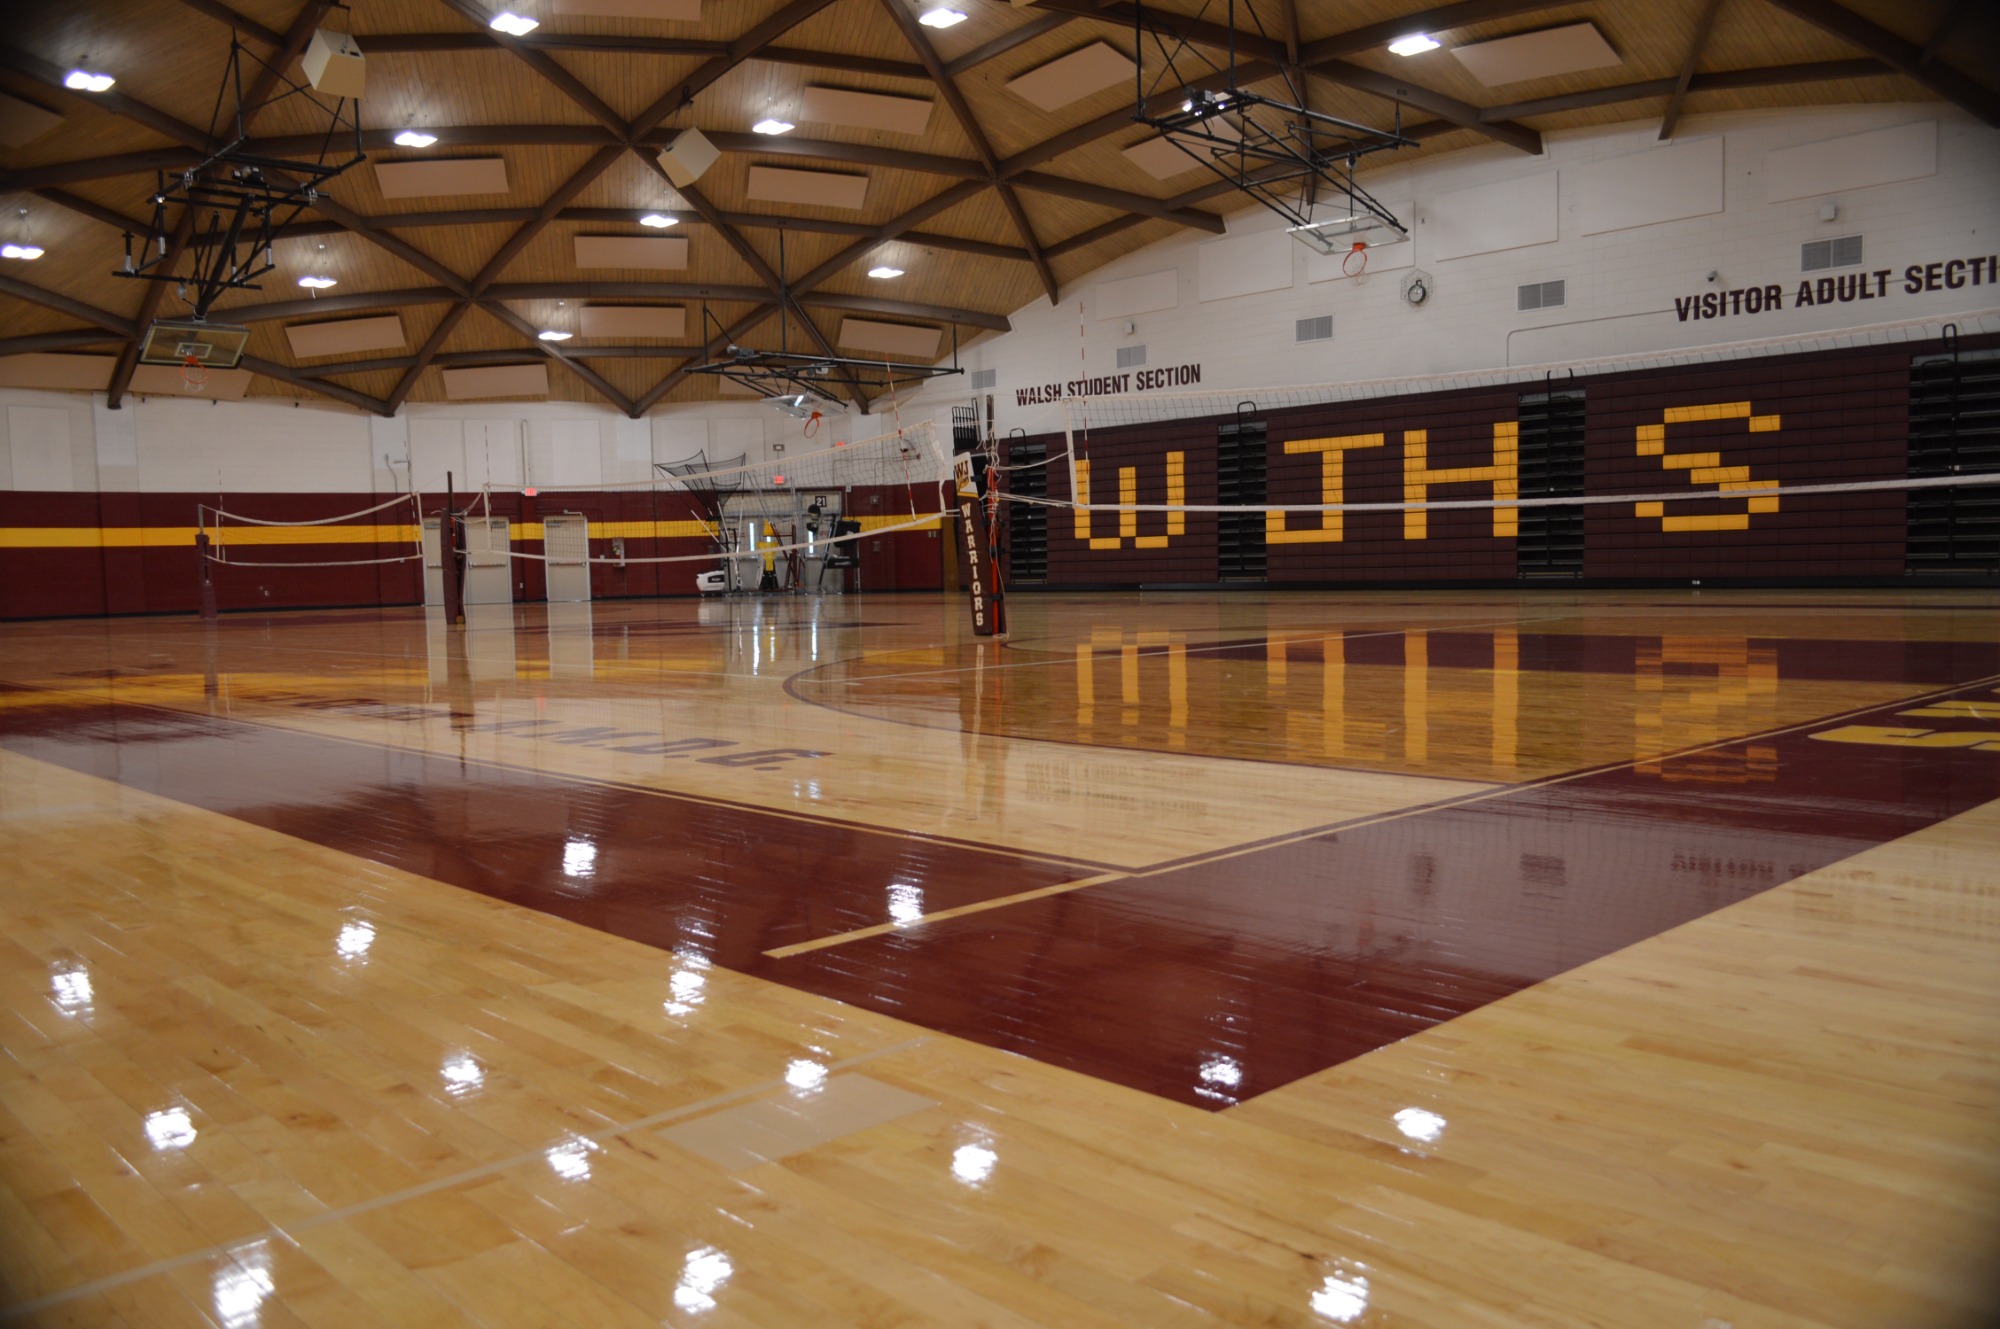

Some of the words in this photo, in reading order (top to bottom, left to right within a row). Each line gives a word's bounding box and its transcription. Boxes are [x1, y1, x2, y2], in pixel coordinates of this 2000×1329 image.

[1674, 284, 1782, 322] VISITOR
[1795, 269, 1892, 308] ADULT
[1904, 255, 2000, 294] SECTI
[1015, 383, 1062, 407] WALSH
[1067, 373, 1131, 397] STUDENT
[1136, 363, 1201, 391] SECTION
[954, 460, 969, 480] WJ
[816, 496, 826, 507] 21
[961, 502, 984, 627] WARRIORS
